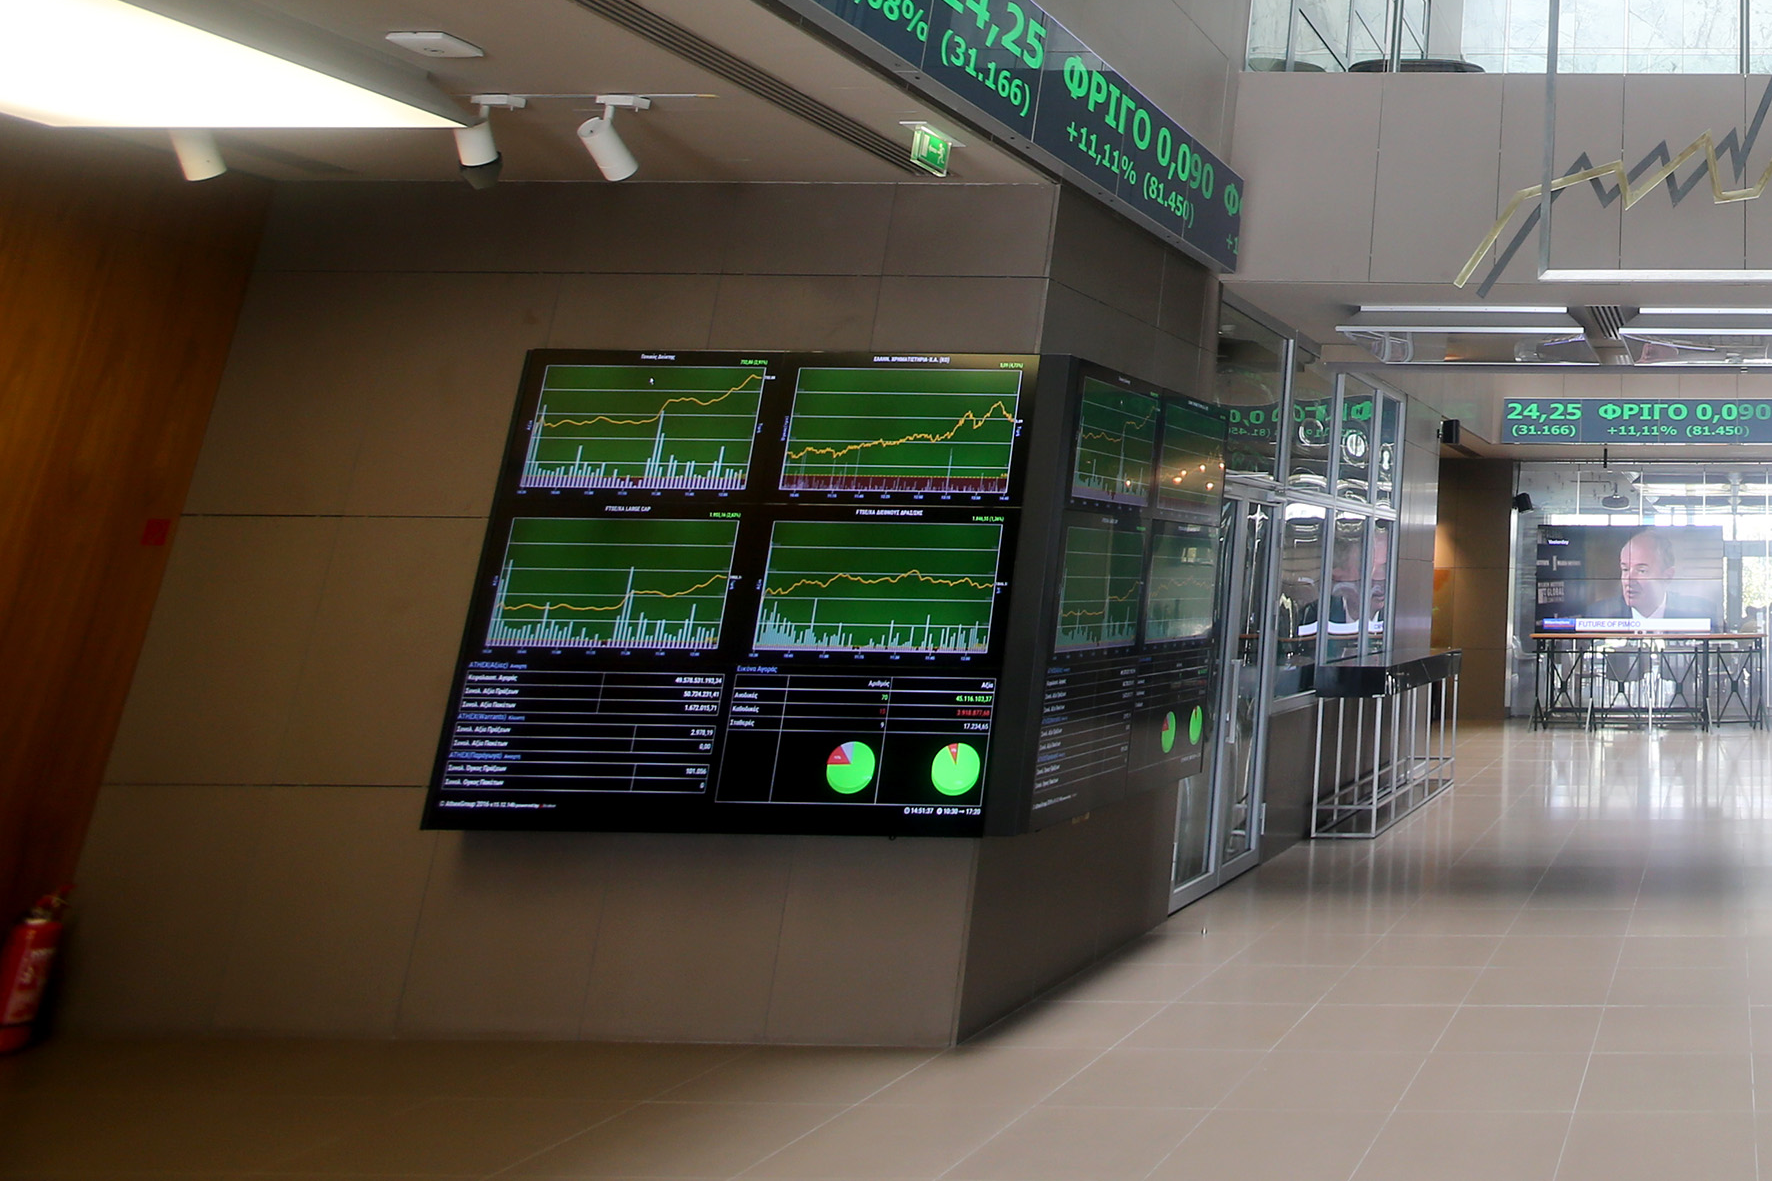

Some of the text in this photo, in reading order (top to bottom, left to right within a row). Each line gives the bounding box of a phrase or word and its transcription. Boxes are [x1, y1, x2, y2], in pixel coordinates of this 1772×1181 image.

[940, 28, 1031, 117] (31.166)
[1066, 121, 1137, 185] +11,11%
[1143, 171, 1195, 229] (81.450)
[1062, 54, 1152, 152] ΦΡΙΓΟ
[1156, 127, 1215, 200] 0,090
[1507, 402, 1583, 423] 24,25
[1597, 403, 1689, 421] ΦΡΙΓΟ
[1695, 403, 1772, 423] 0,090
[1511, 424, 1577, 437] (31.166)
[1607, 425, 1678, 437] +11,11%
[1685, 425, 1750, 438] (81.450)
[1578, 620, 1606, 628] FUTURE
[1607, 620, 1617, 628] OF
[1617, 620, 1641, 628] PIMCO
